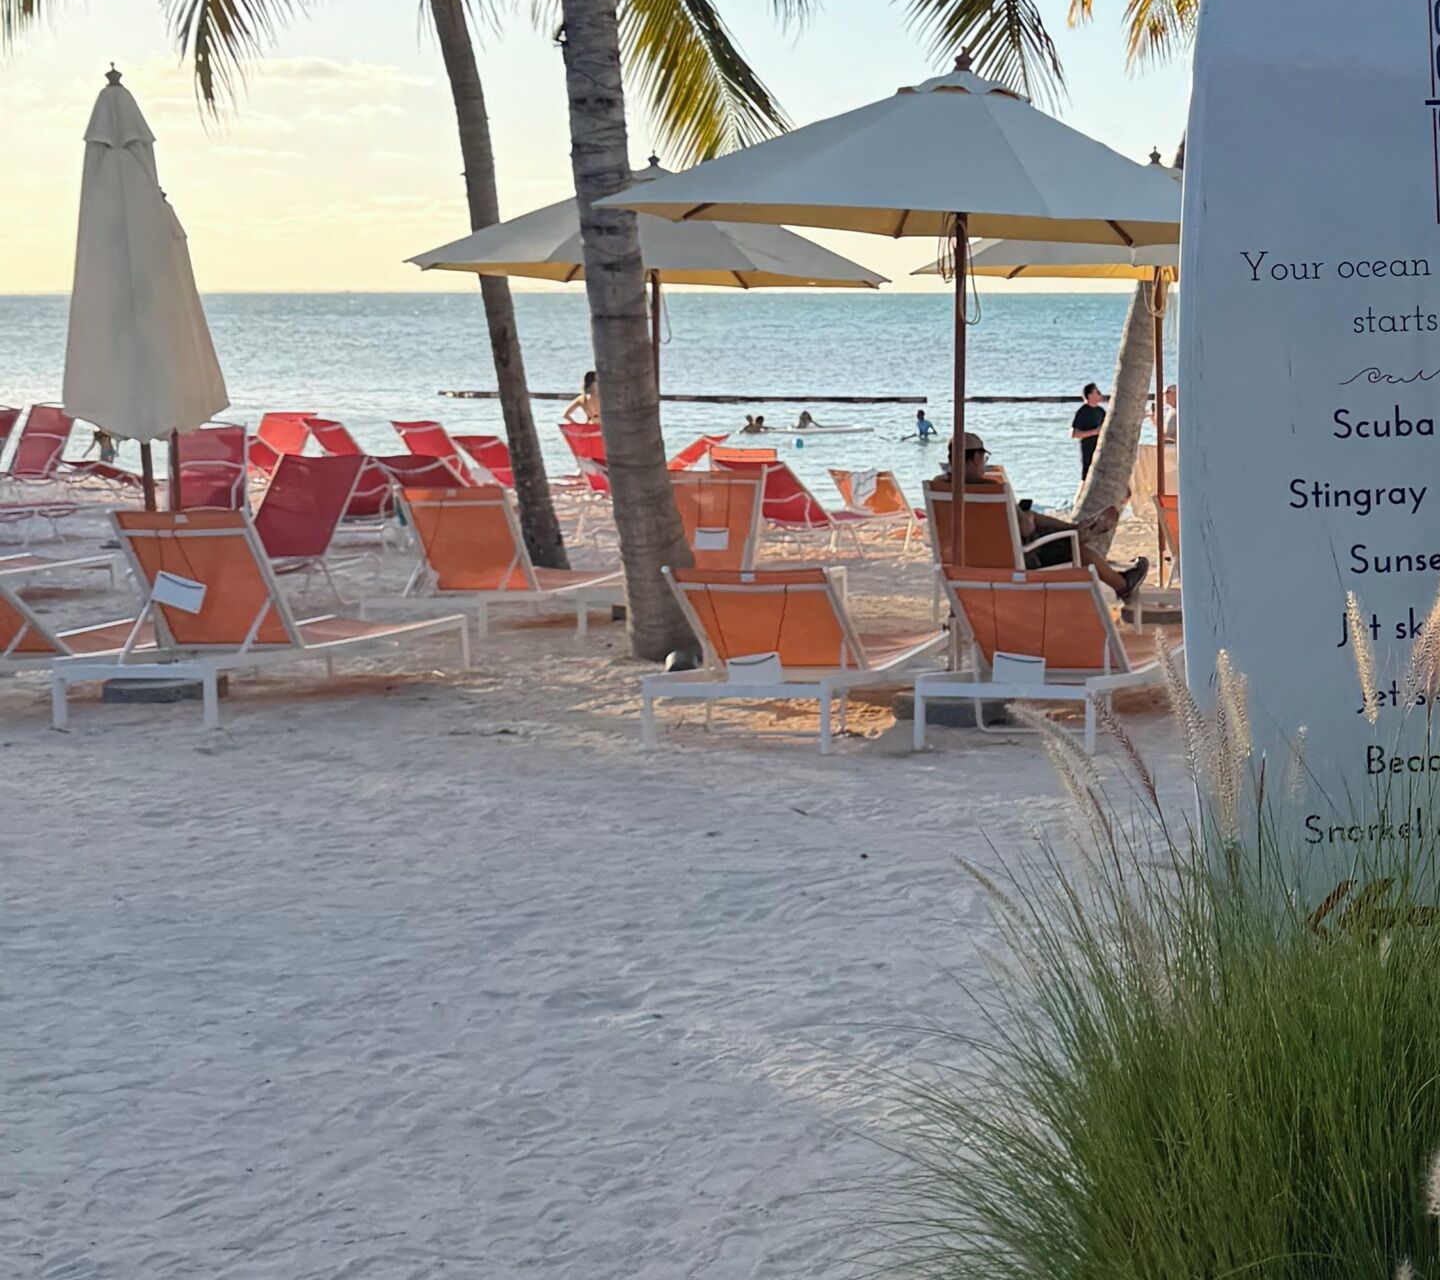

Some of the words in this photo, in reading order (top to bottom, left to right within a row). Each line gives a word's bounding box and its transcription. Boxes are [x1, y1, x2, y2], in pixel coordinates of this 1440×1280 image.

[1240, 251, 1324, 282] Your
[1337, 258, 1432, 280] ocean
[1353, 306, 1438, 334] starts
[1332, 405, 1434, 439] Scuba
[1289, 479, 1427, 515] Stingray
[1337, 612, 1381, 648] Jt
[1395, 607, 1425, 639] sk
[1304, 807, 1423, 844] Snorkel
